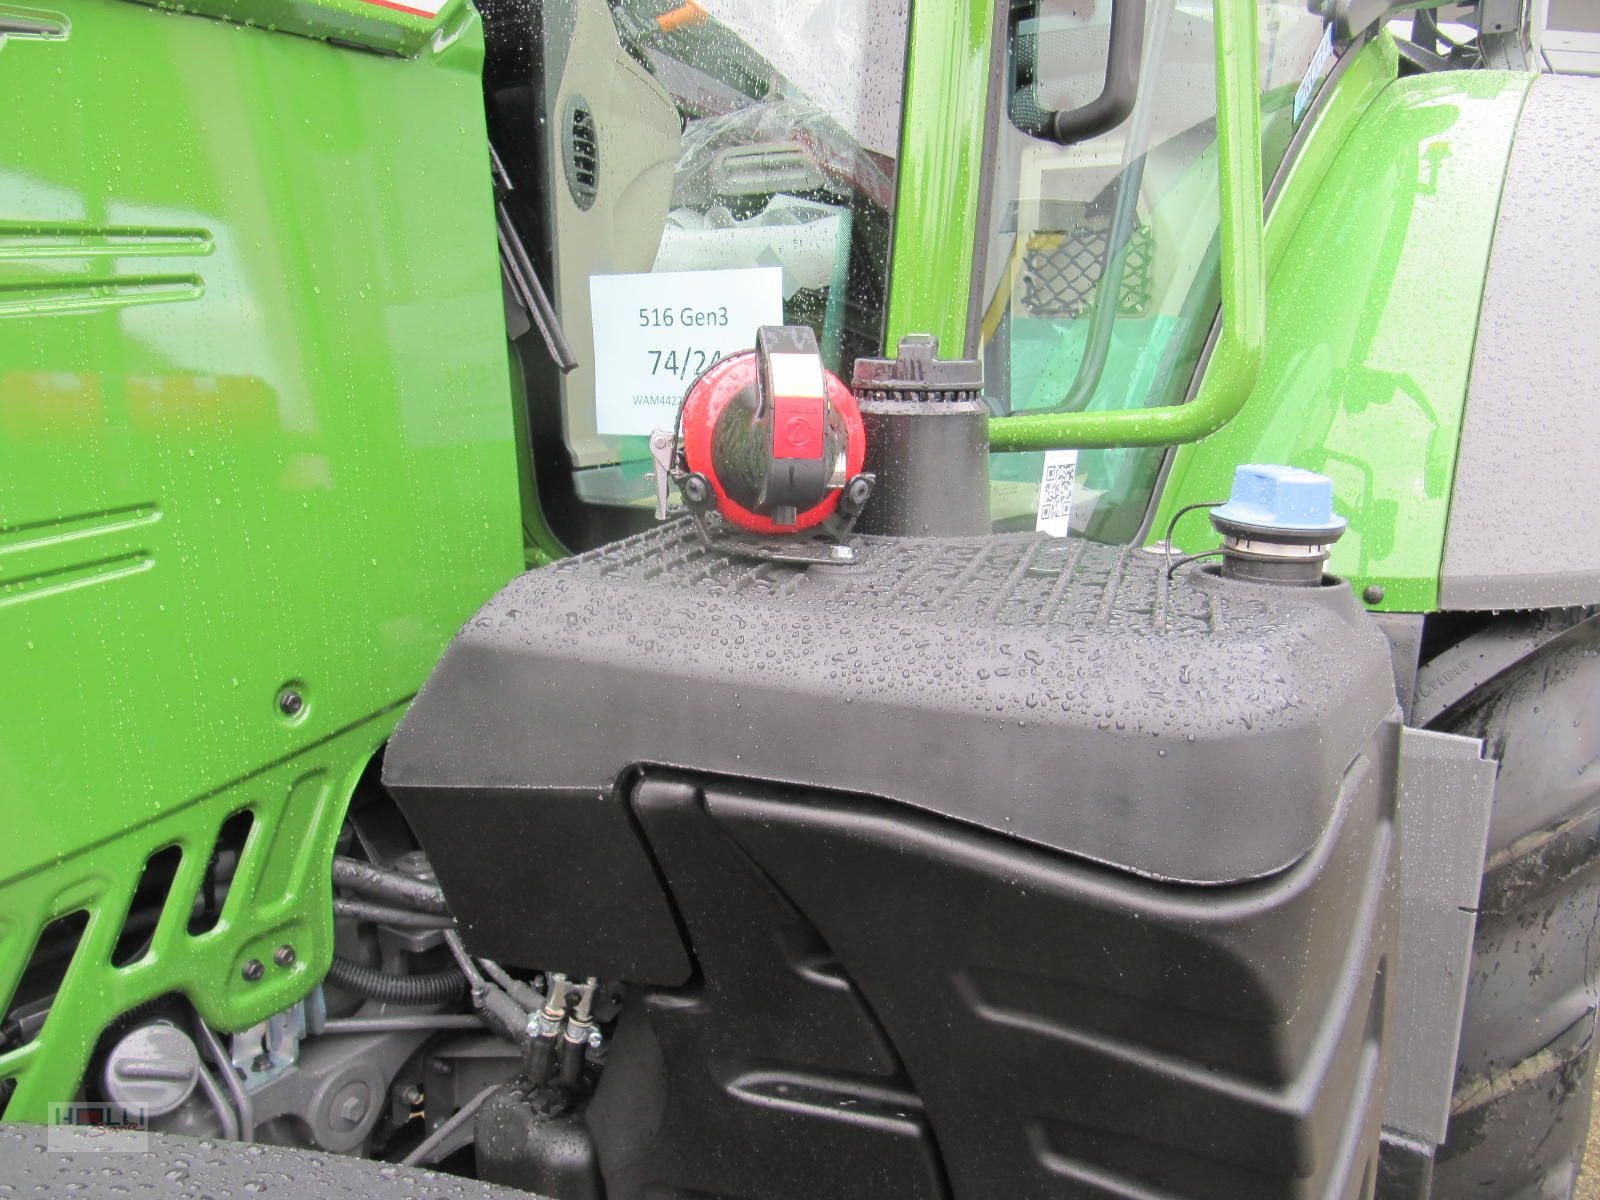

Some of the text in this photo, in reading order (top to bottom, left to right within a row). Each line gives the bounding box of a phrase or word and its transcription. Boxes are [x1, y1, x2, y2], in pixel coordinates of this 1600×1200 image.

[639, 306, 729, 328] 516 Gen3
[632, 394, 683, 406] WAM4422
